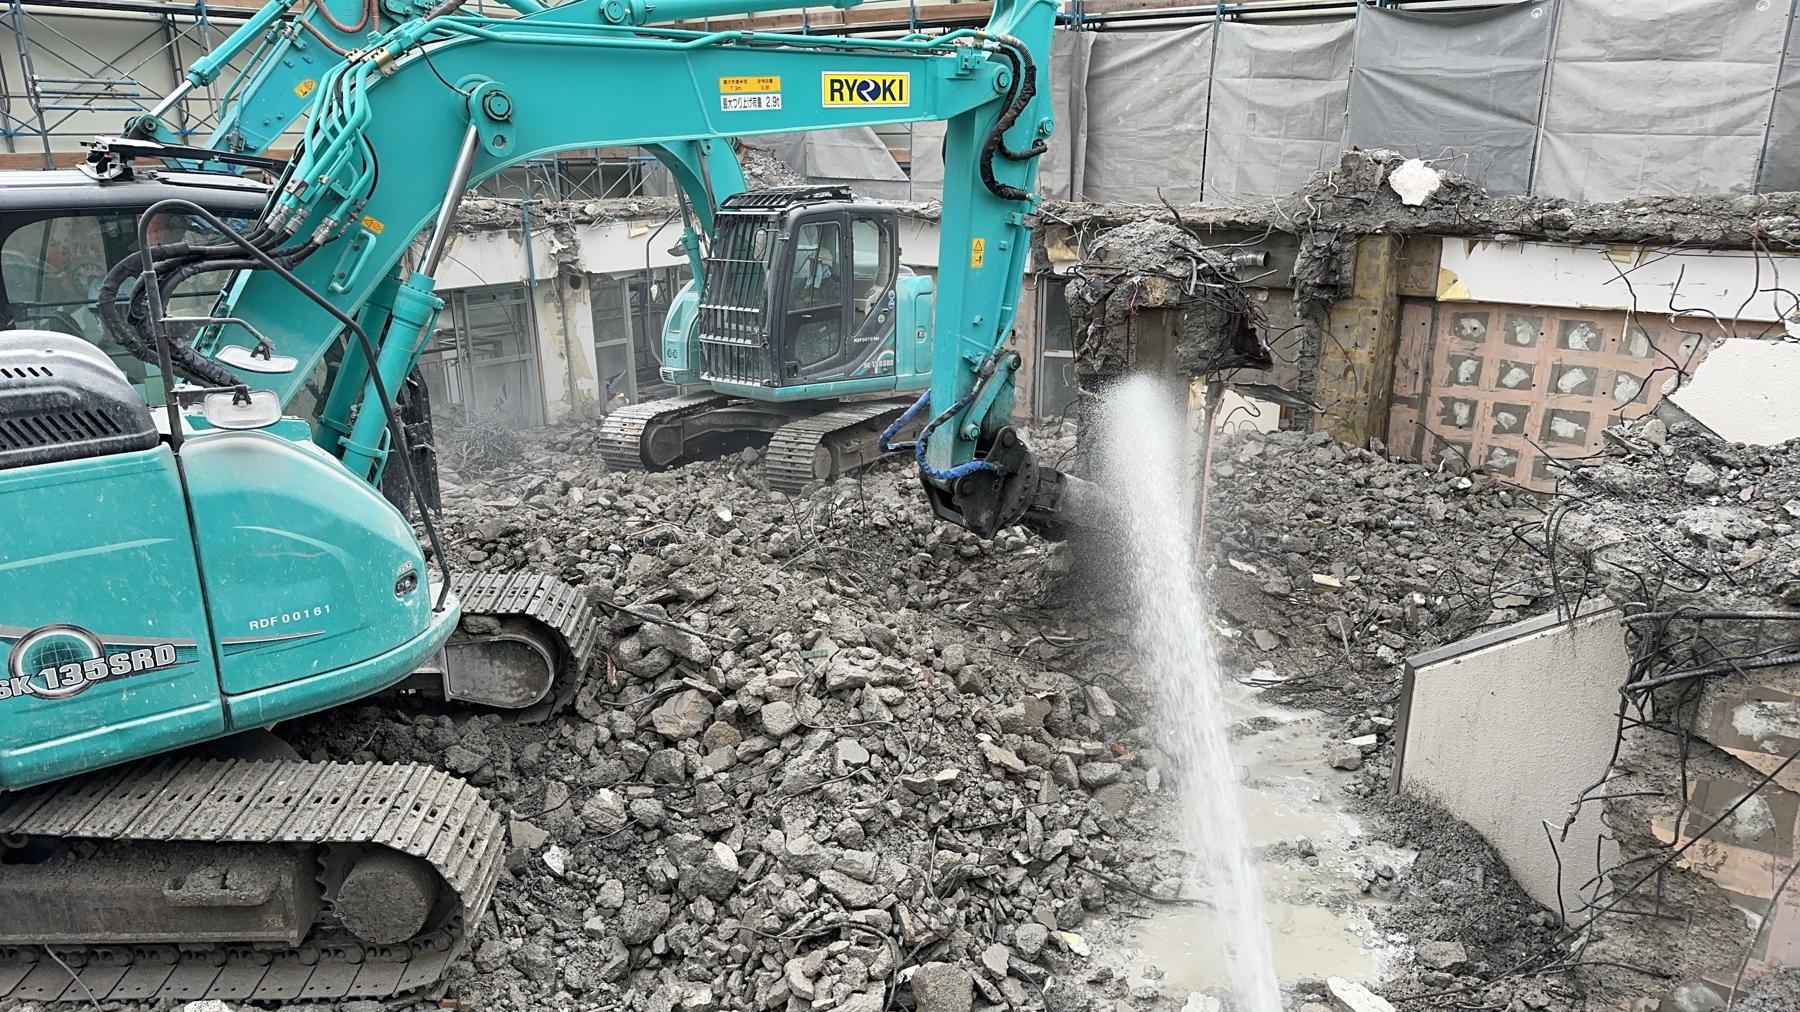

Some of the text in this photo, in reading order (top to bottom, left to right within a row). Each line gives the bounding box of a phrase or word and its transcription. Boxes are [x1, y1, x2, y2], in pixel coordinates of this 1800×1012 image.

[765, 95, 780, 108] 2.9t
[829, 78, 903, 102] RYOKI
[249, 604, 331, 631] RDF00161
[0, 643, 176, 699] SK 135SRD
